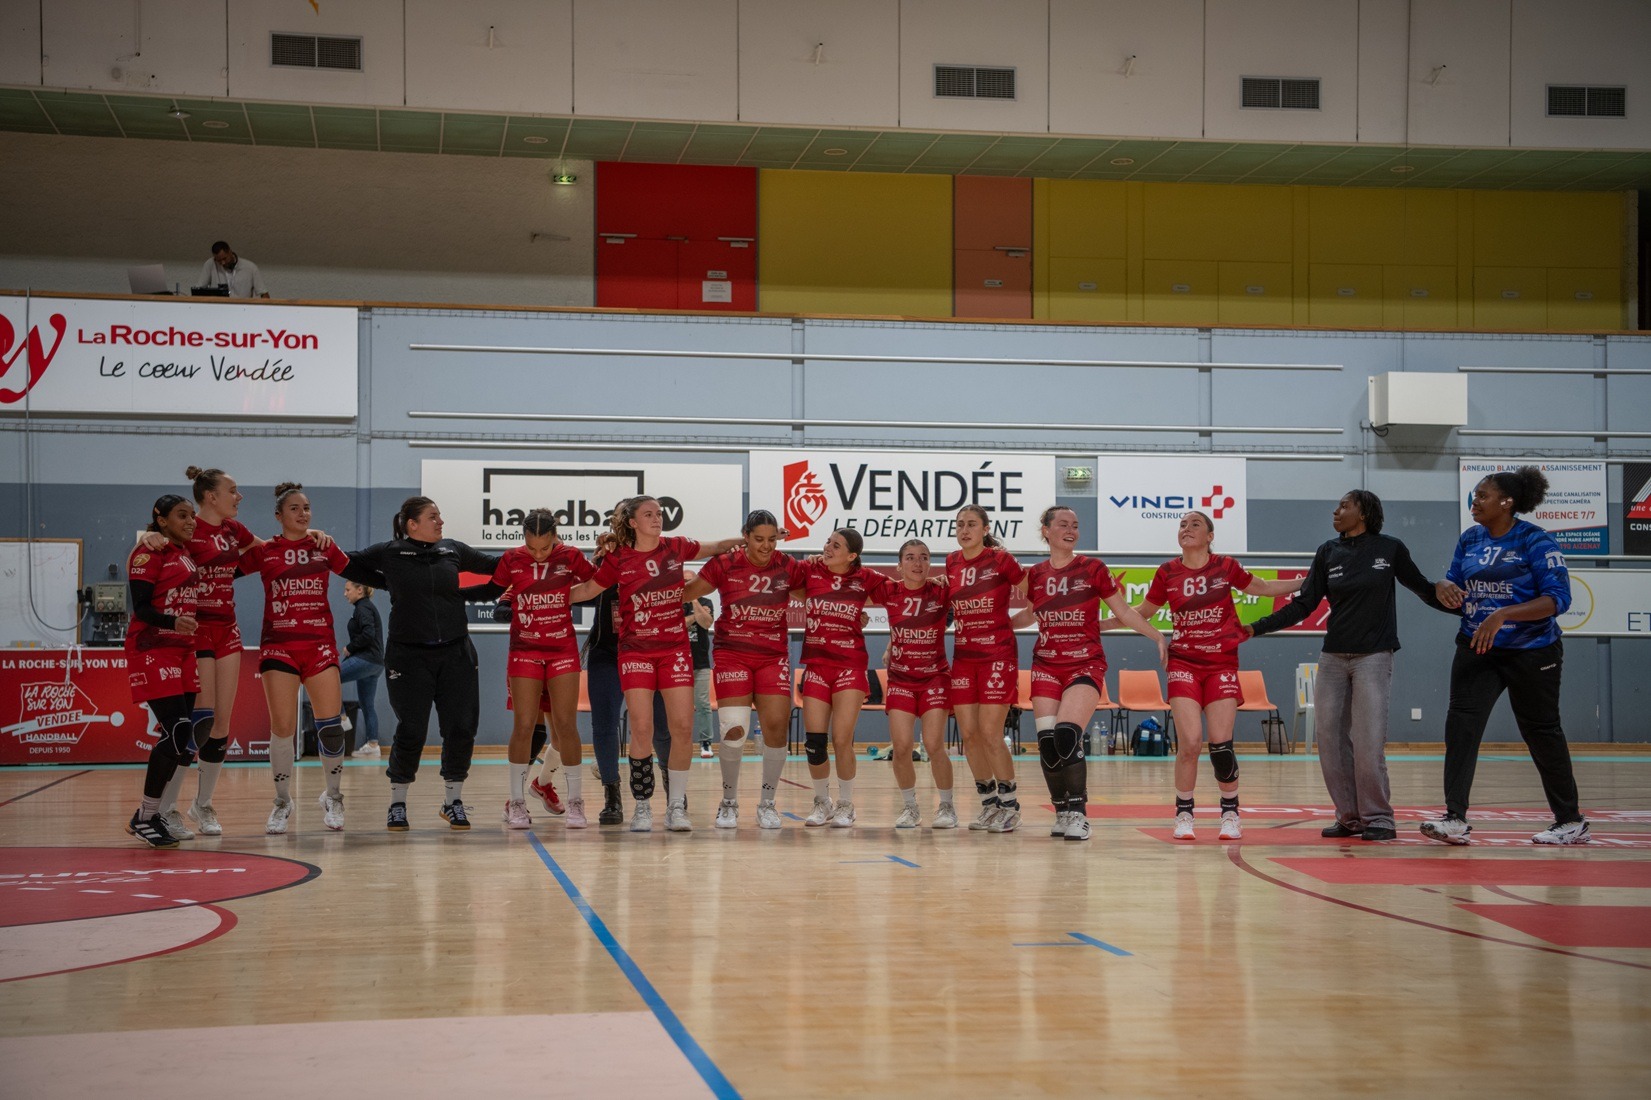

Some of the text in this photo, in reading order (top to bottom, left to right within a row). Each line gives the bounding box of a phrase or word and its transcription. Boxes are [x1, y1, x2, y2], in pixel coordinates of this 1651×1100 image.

[77, 325, 319, 350] La Roche-sur-Yon
[100, 355, 295, 382] Le cœur Vendée
[829, 461, 1024, 512] VENDÉE
[1109, 495, 1194, 509] VINCI
[483, 499, 614, 526] hadb
[1535, 511, 1596, 520] URGENCE 7/7
[863, 514, 1023, 538] DÉPARTENT
[483, 529, 492, 540] la
[495, 529, 524, 540] chaîn
[576, 531, 590, 541] les
[285, 549, 309, 565] 98
[1479, 546, 1502, 566] 37
[530, 562, 549, 580] 17
[645, 559, 660, 577] 9
[831, 575, 842, 590] 3
[960, 567, 977, 586] 19
[748, 575, 773, 594] 22
[1046, 577, 1068, 595] 64
[1183, 576, 1208, 597] 63
[1470, 579, 1513, 594] VENDÉE
[902, 597, 922, 616] 27
[951, 596, 994, 611] VENDÉE
[1039, 608, 1085, 621] VENDÉE
[1179, 605, 1223, 620] VENDÉE
[895, 627, 938, 639] VENDÉE
[2, 660, 16, 669] LA
[20, 659, 108, 669] ROCHE-SUR-YON
[41, 685, 76, 699] ROCHE
[27, 698, 74, 711] SUR YON
[36, 711, 82, 728] VENDEE
[26, 733, 78, 741] HANDBALL
[136, 740, 153, 751] CLUB
[249, 746, 269, 755] hand
